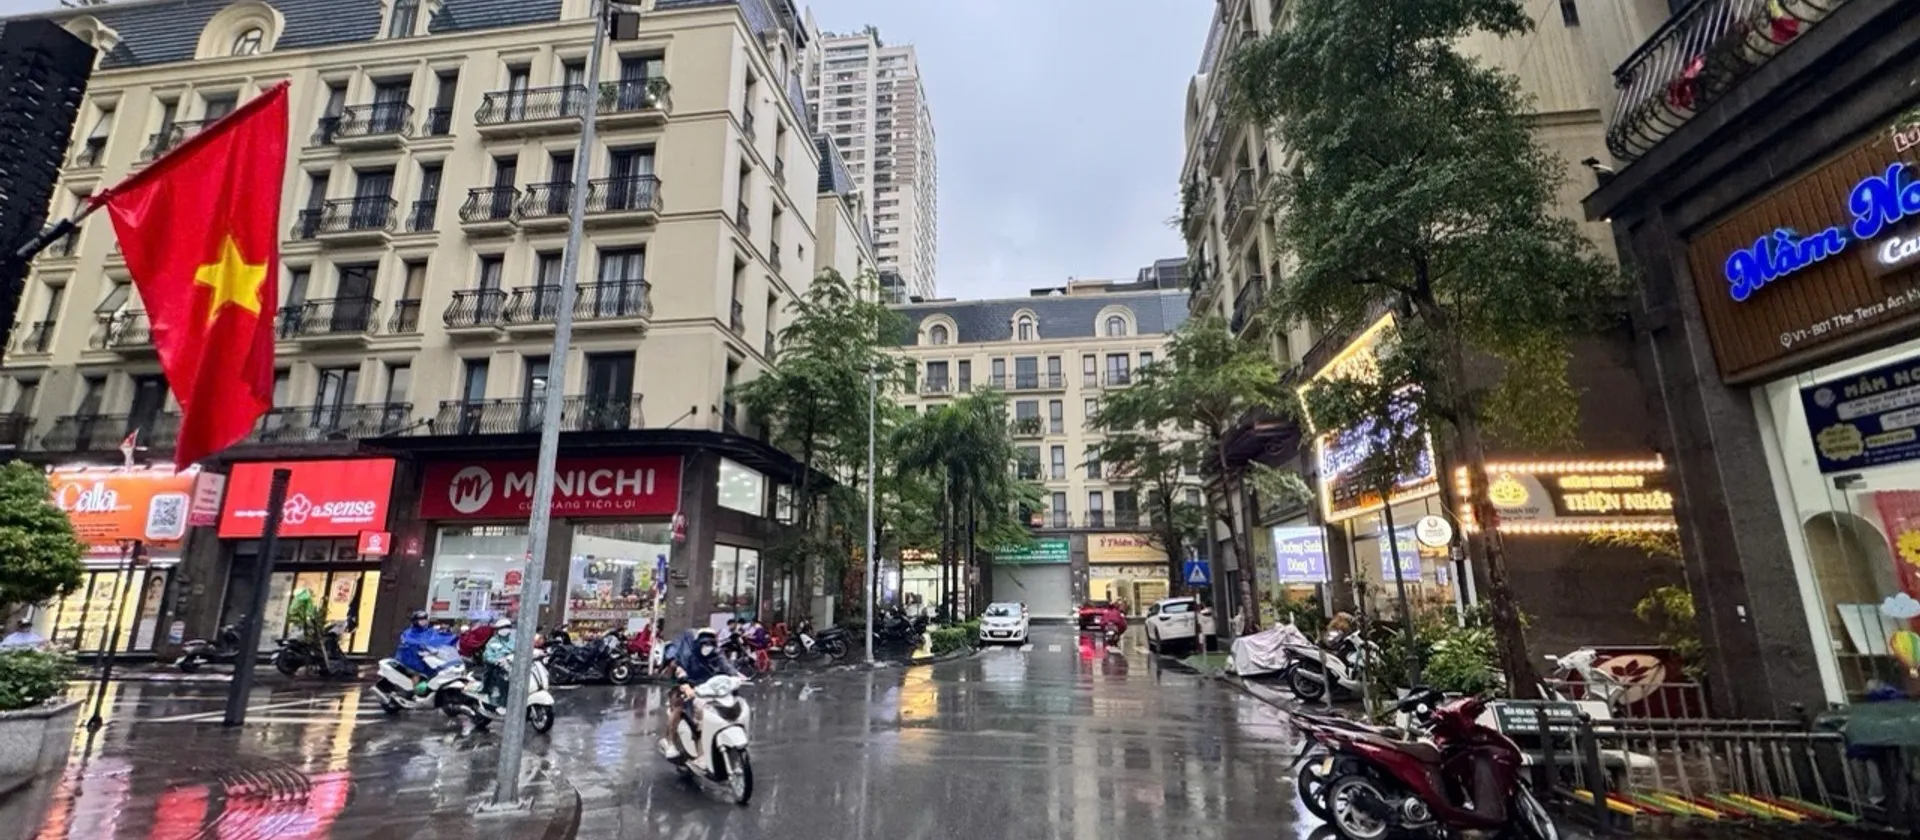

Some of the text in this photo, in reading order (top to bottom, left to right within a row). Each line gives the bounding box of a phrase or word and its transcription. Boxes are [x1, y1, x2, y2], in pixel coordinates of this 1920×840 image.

[1832, 313, 1854, 328] The
[1855, 303, 1885, 319] Terra
[503, 468, 655, 499] MNICHI
